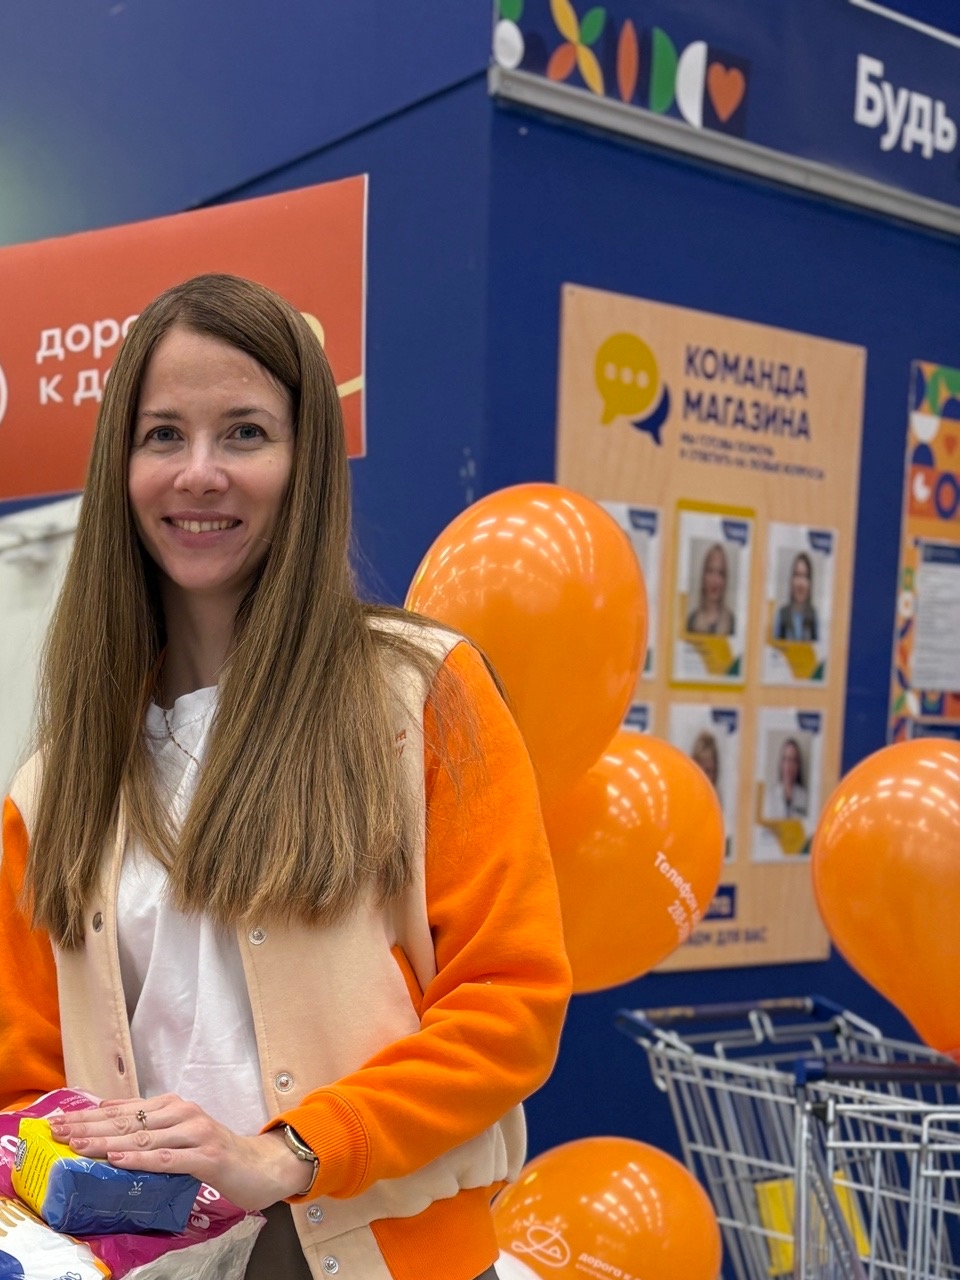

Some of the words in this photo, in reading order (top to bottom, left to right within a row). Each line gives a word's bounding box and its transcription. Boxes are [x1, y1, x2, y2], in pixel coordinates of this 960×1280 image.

[854, 53, 957, 159] Будь
[38, 374, 63, 405] к
[73, 368, 111, 406] д
[685, 344, 808, 398] КОМАНДА
[682, 389, 811, 442] МАГАЗИНА
[578, 1251, 622, 1278] дорога
